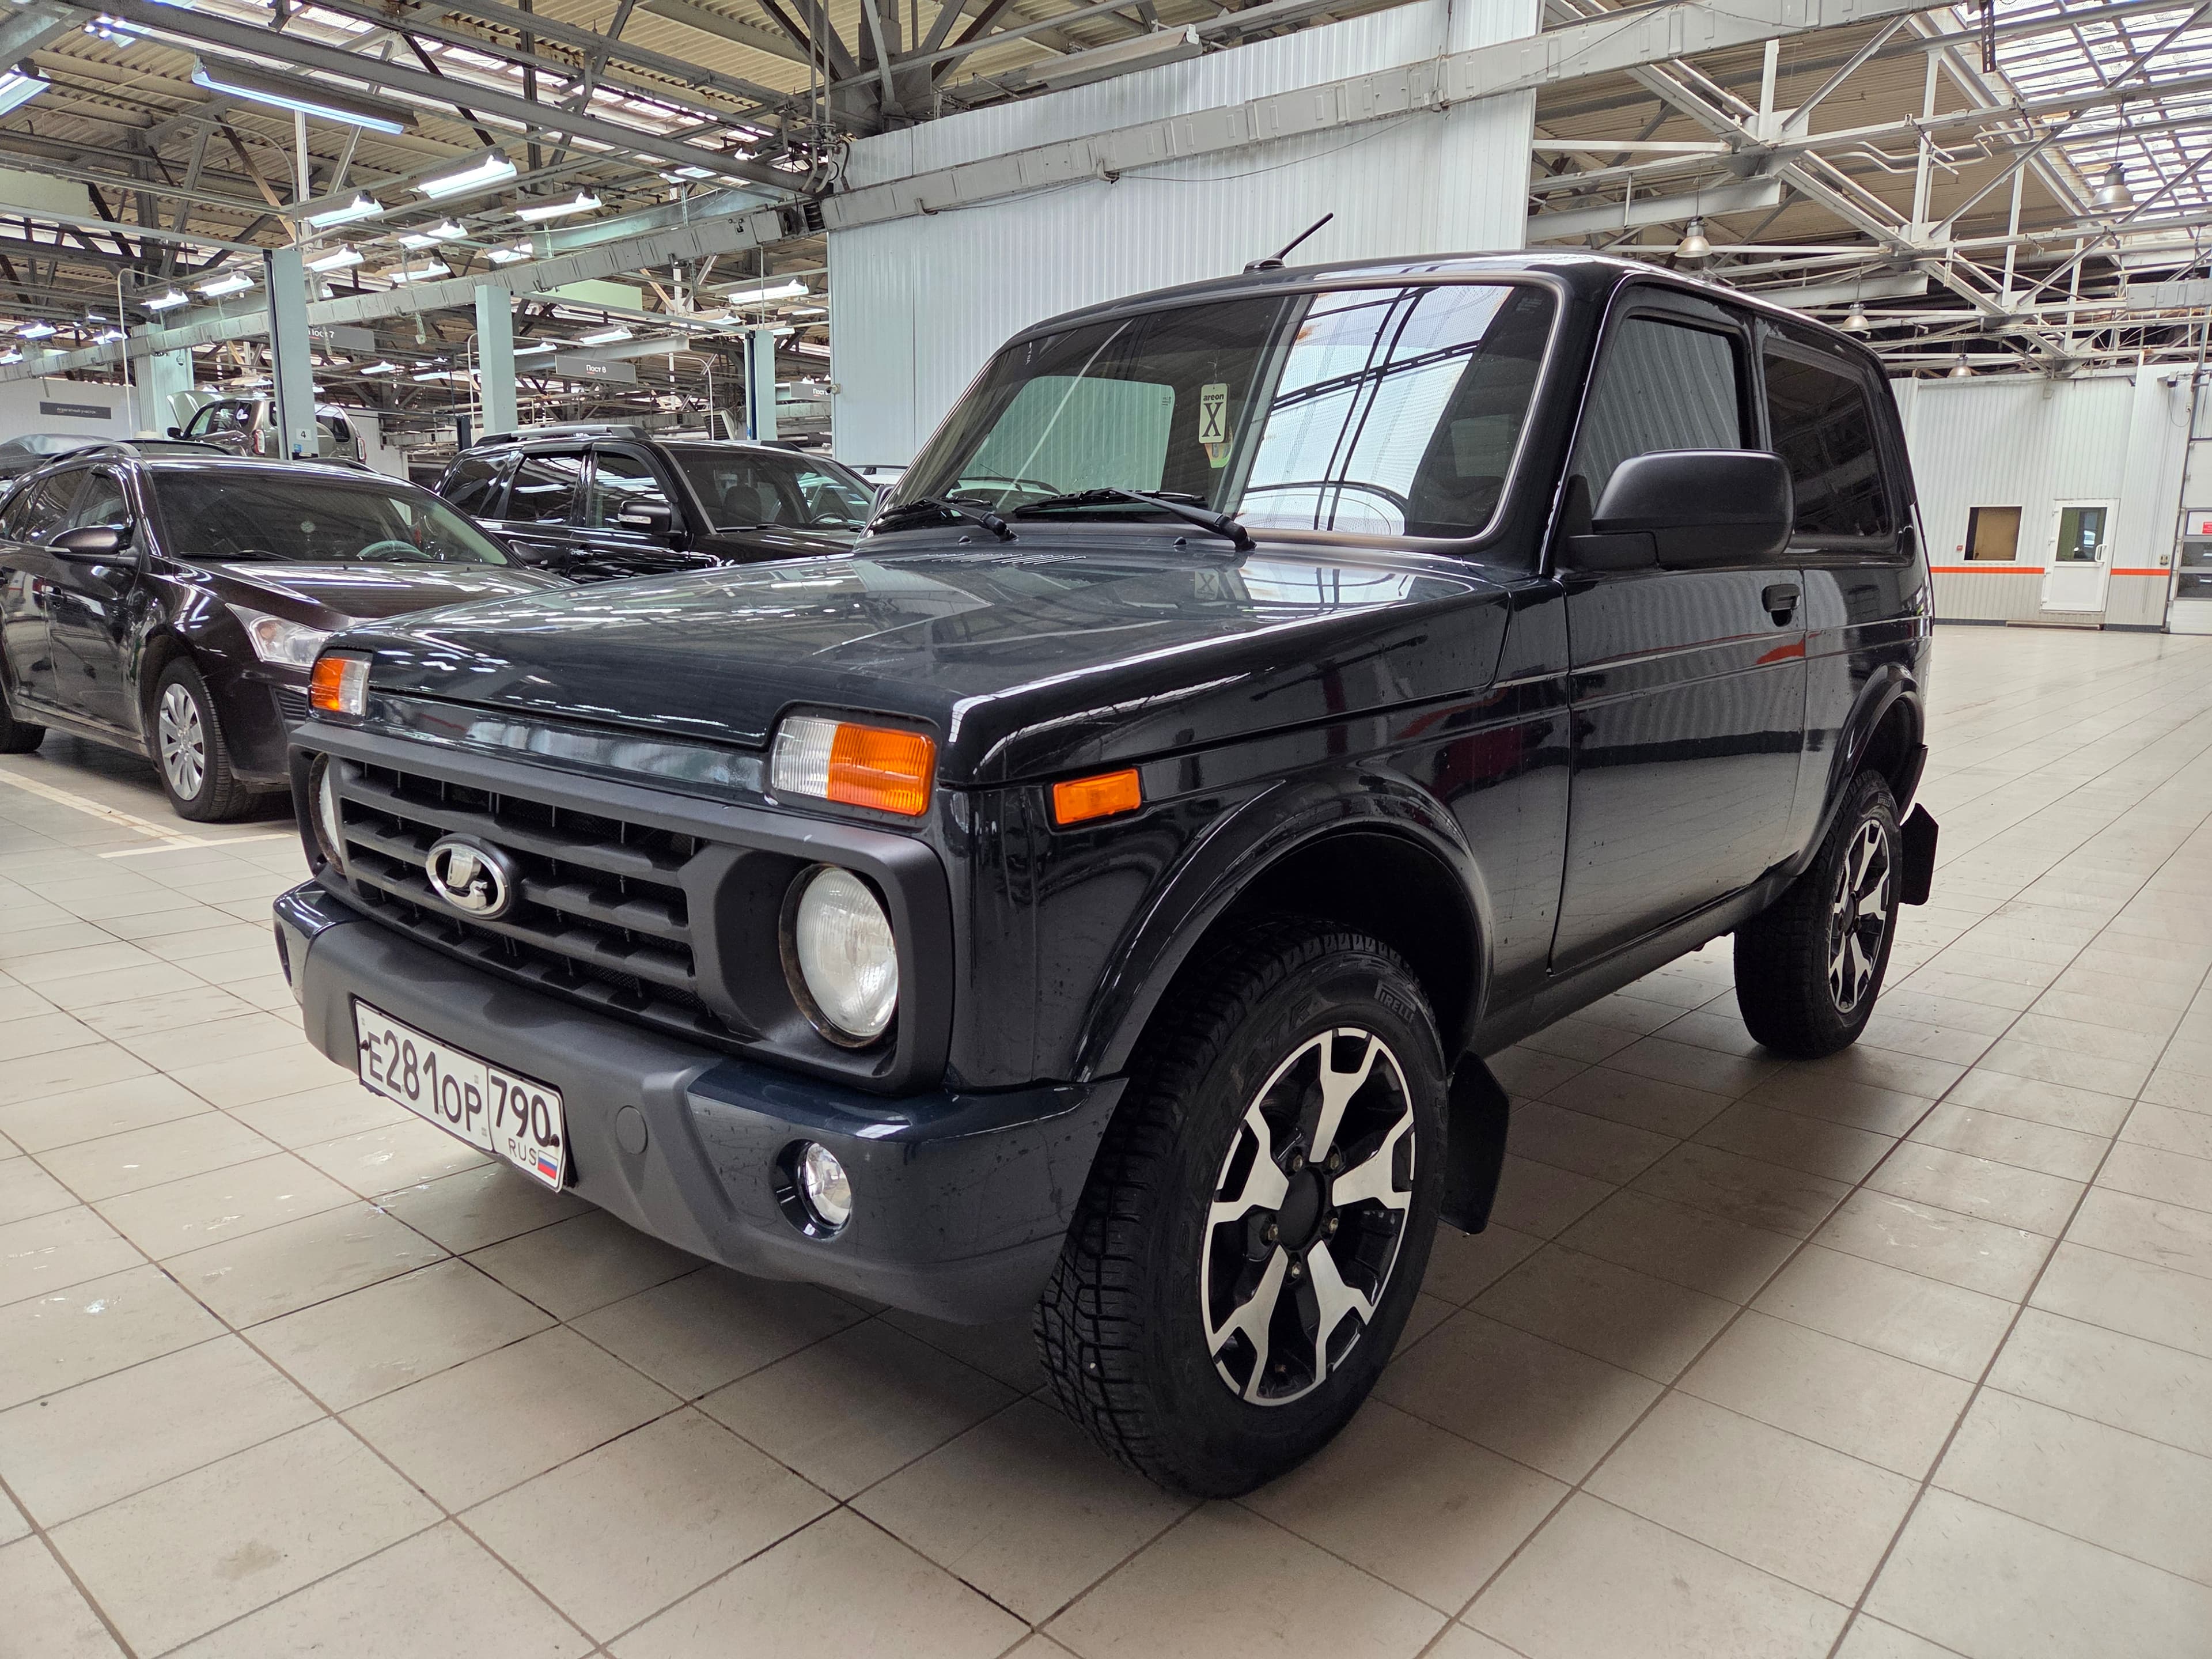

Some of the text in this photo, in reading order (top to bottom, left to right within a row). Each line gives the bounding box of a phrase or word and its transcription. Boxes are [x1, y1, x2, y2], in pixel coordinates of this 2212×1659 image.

[329, 331, 335, 339] 7
[300, 430, 306, 438] 4
[1202, 402, 1224, 437] X
[1373, 979, 1416, 1023] PIRELLI
[490, 1075, 550, 1147] 790
[507, 1138, 536, 1166] RUS
